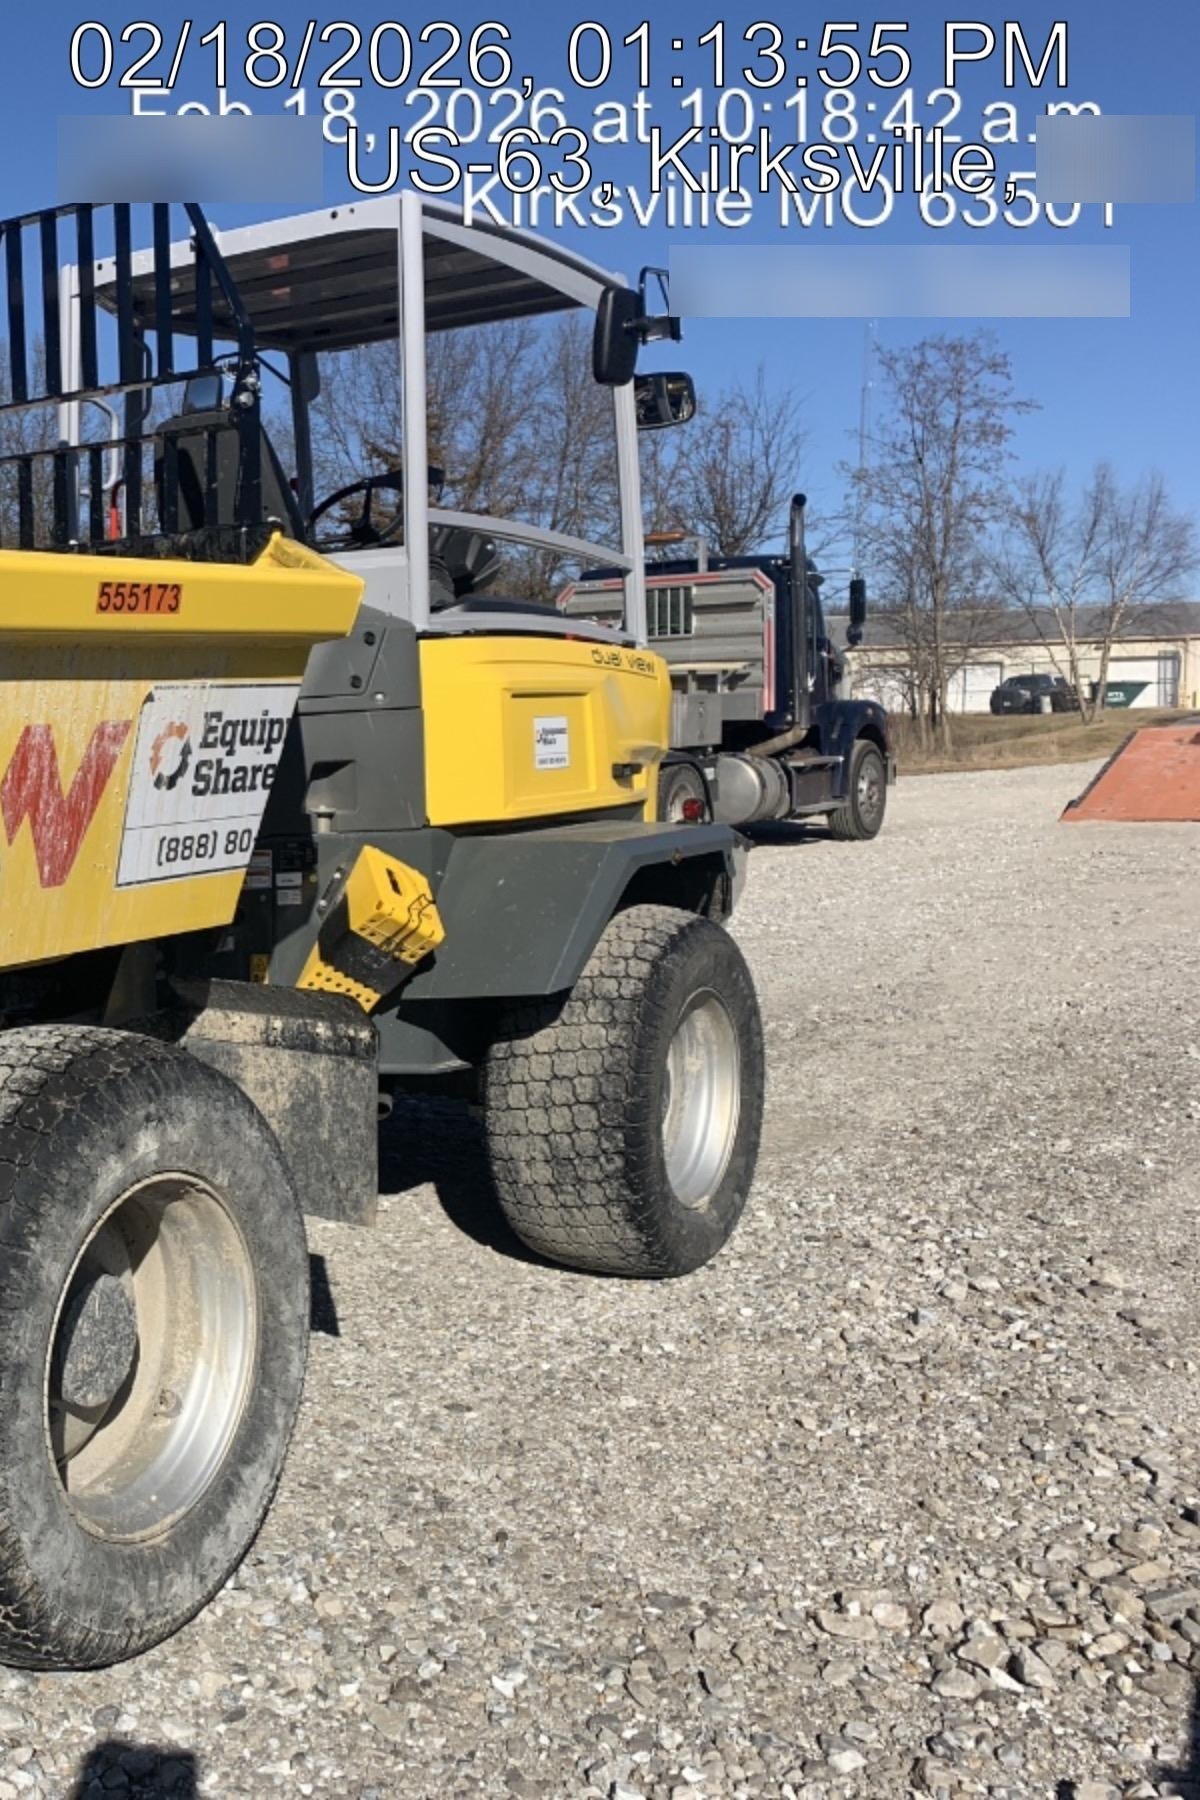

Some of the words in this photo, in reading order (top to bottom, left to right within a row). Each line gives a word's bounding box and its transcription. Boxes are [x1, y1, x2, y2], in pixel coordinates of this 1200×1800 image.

[98, 582, 182, 613] 555173
[198, 708, 291, 757] Equip
[191, 757, 278, 797] Share
[157, 829, 219, 867] (888)
